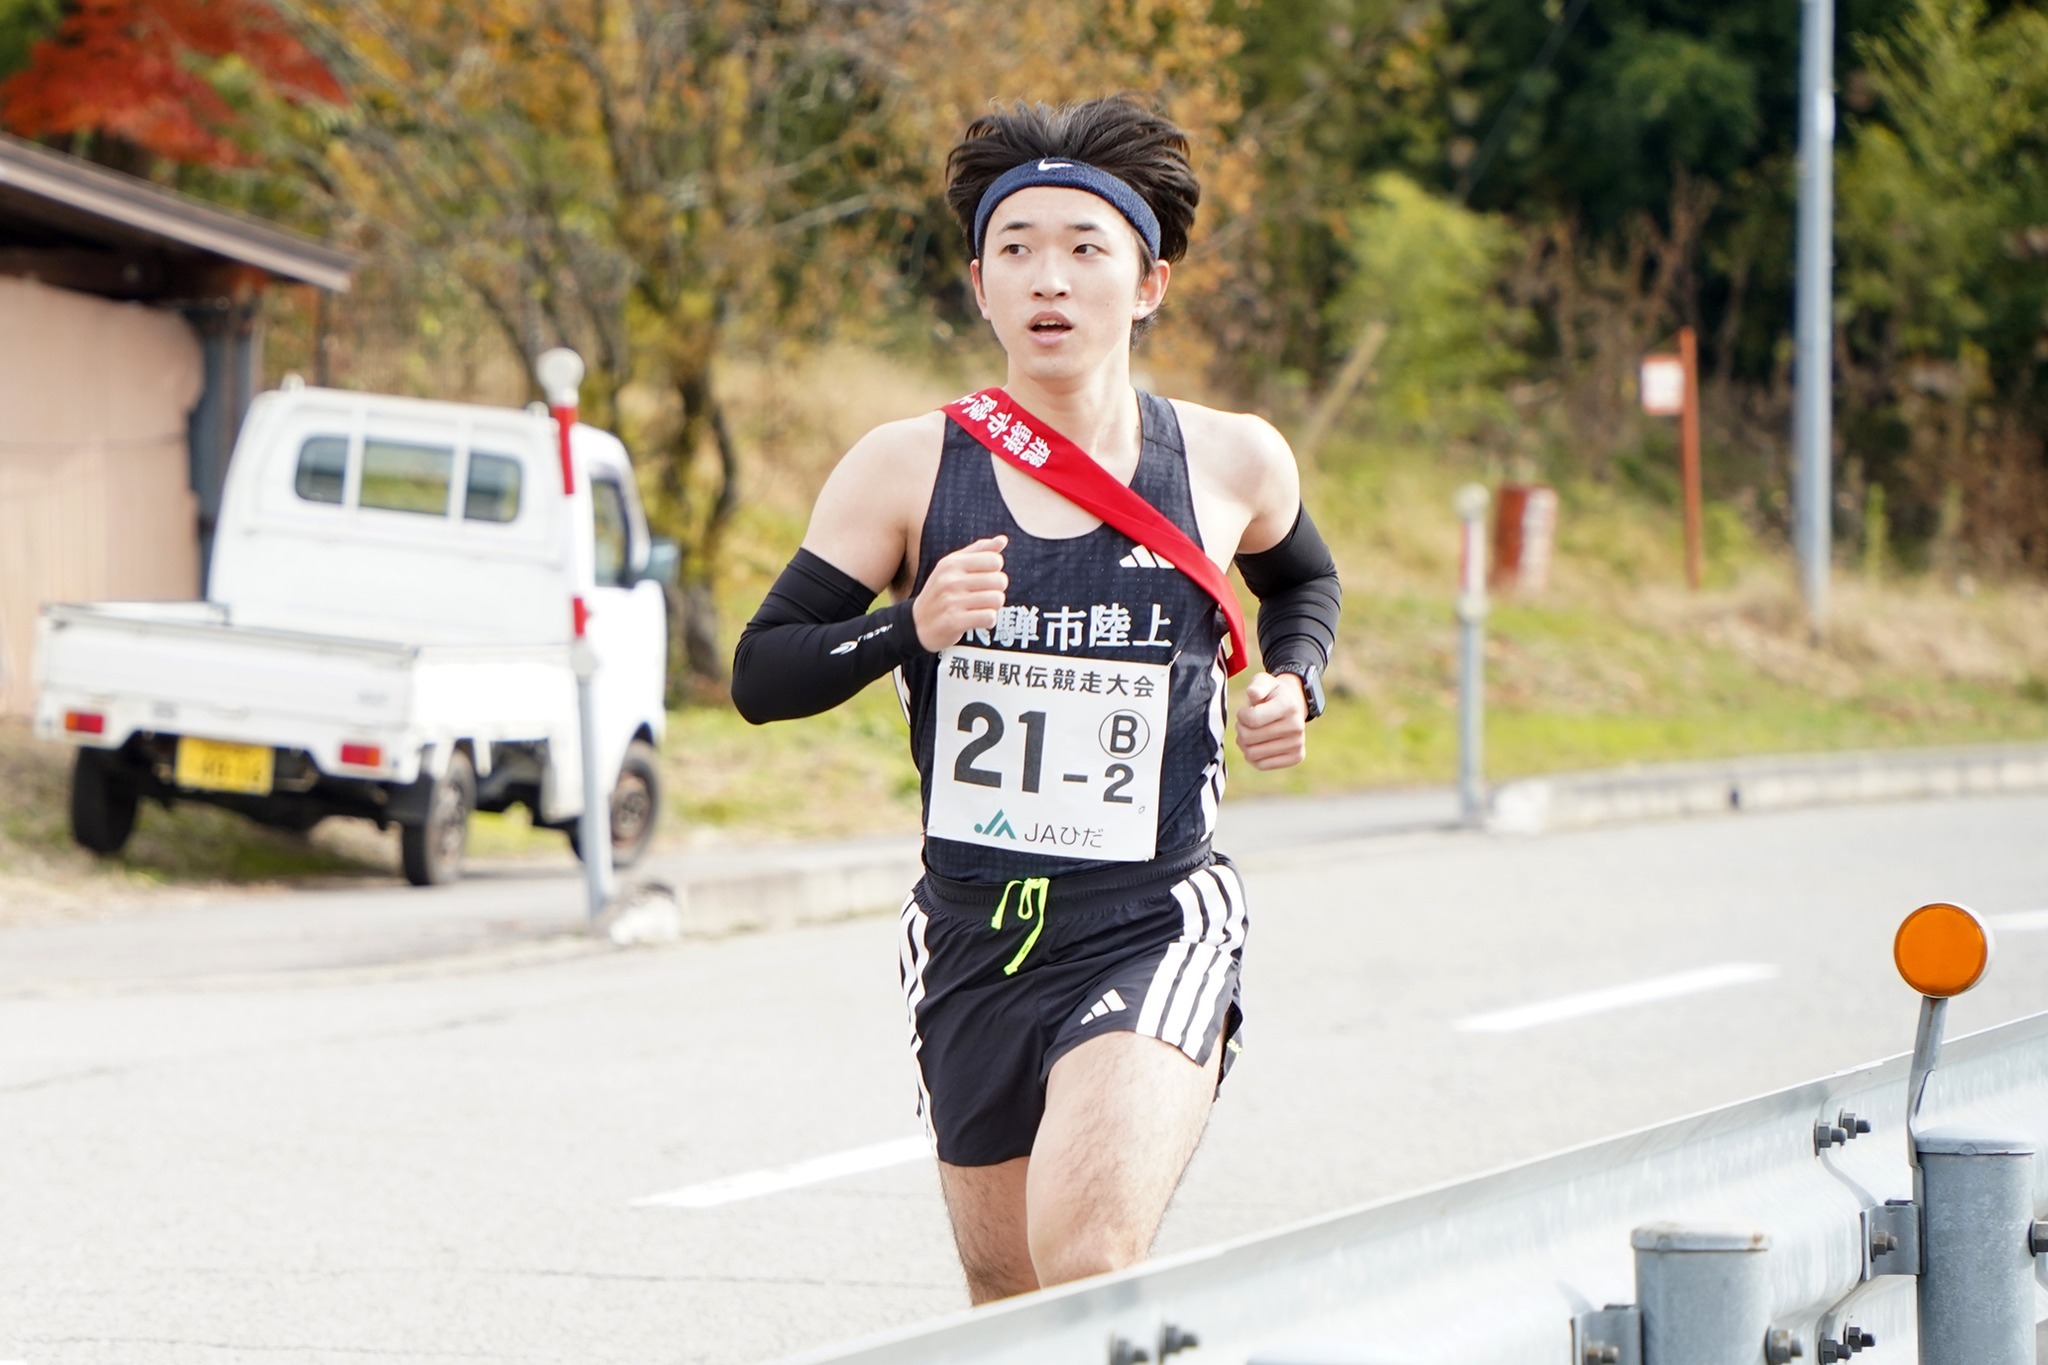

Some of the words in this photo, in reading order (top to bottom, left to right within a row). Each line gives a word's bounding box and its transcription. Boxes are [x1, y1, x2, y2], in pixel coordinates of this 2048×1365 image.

[949, 656, 1156, 698] 飛騨駅伝競走大会
